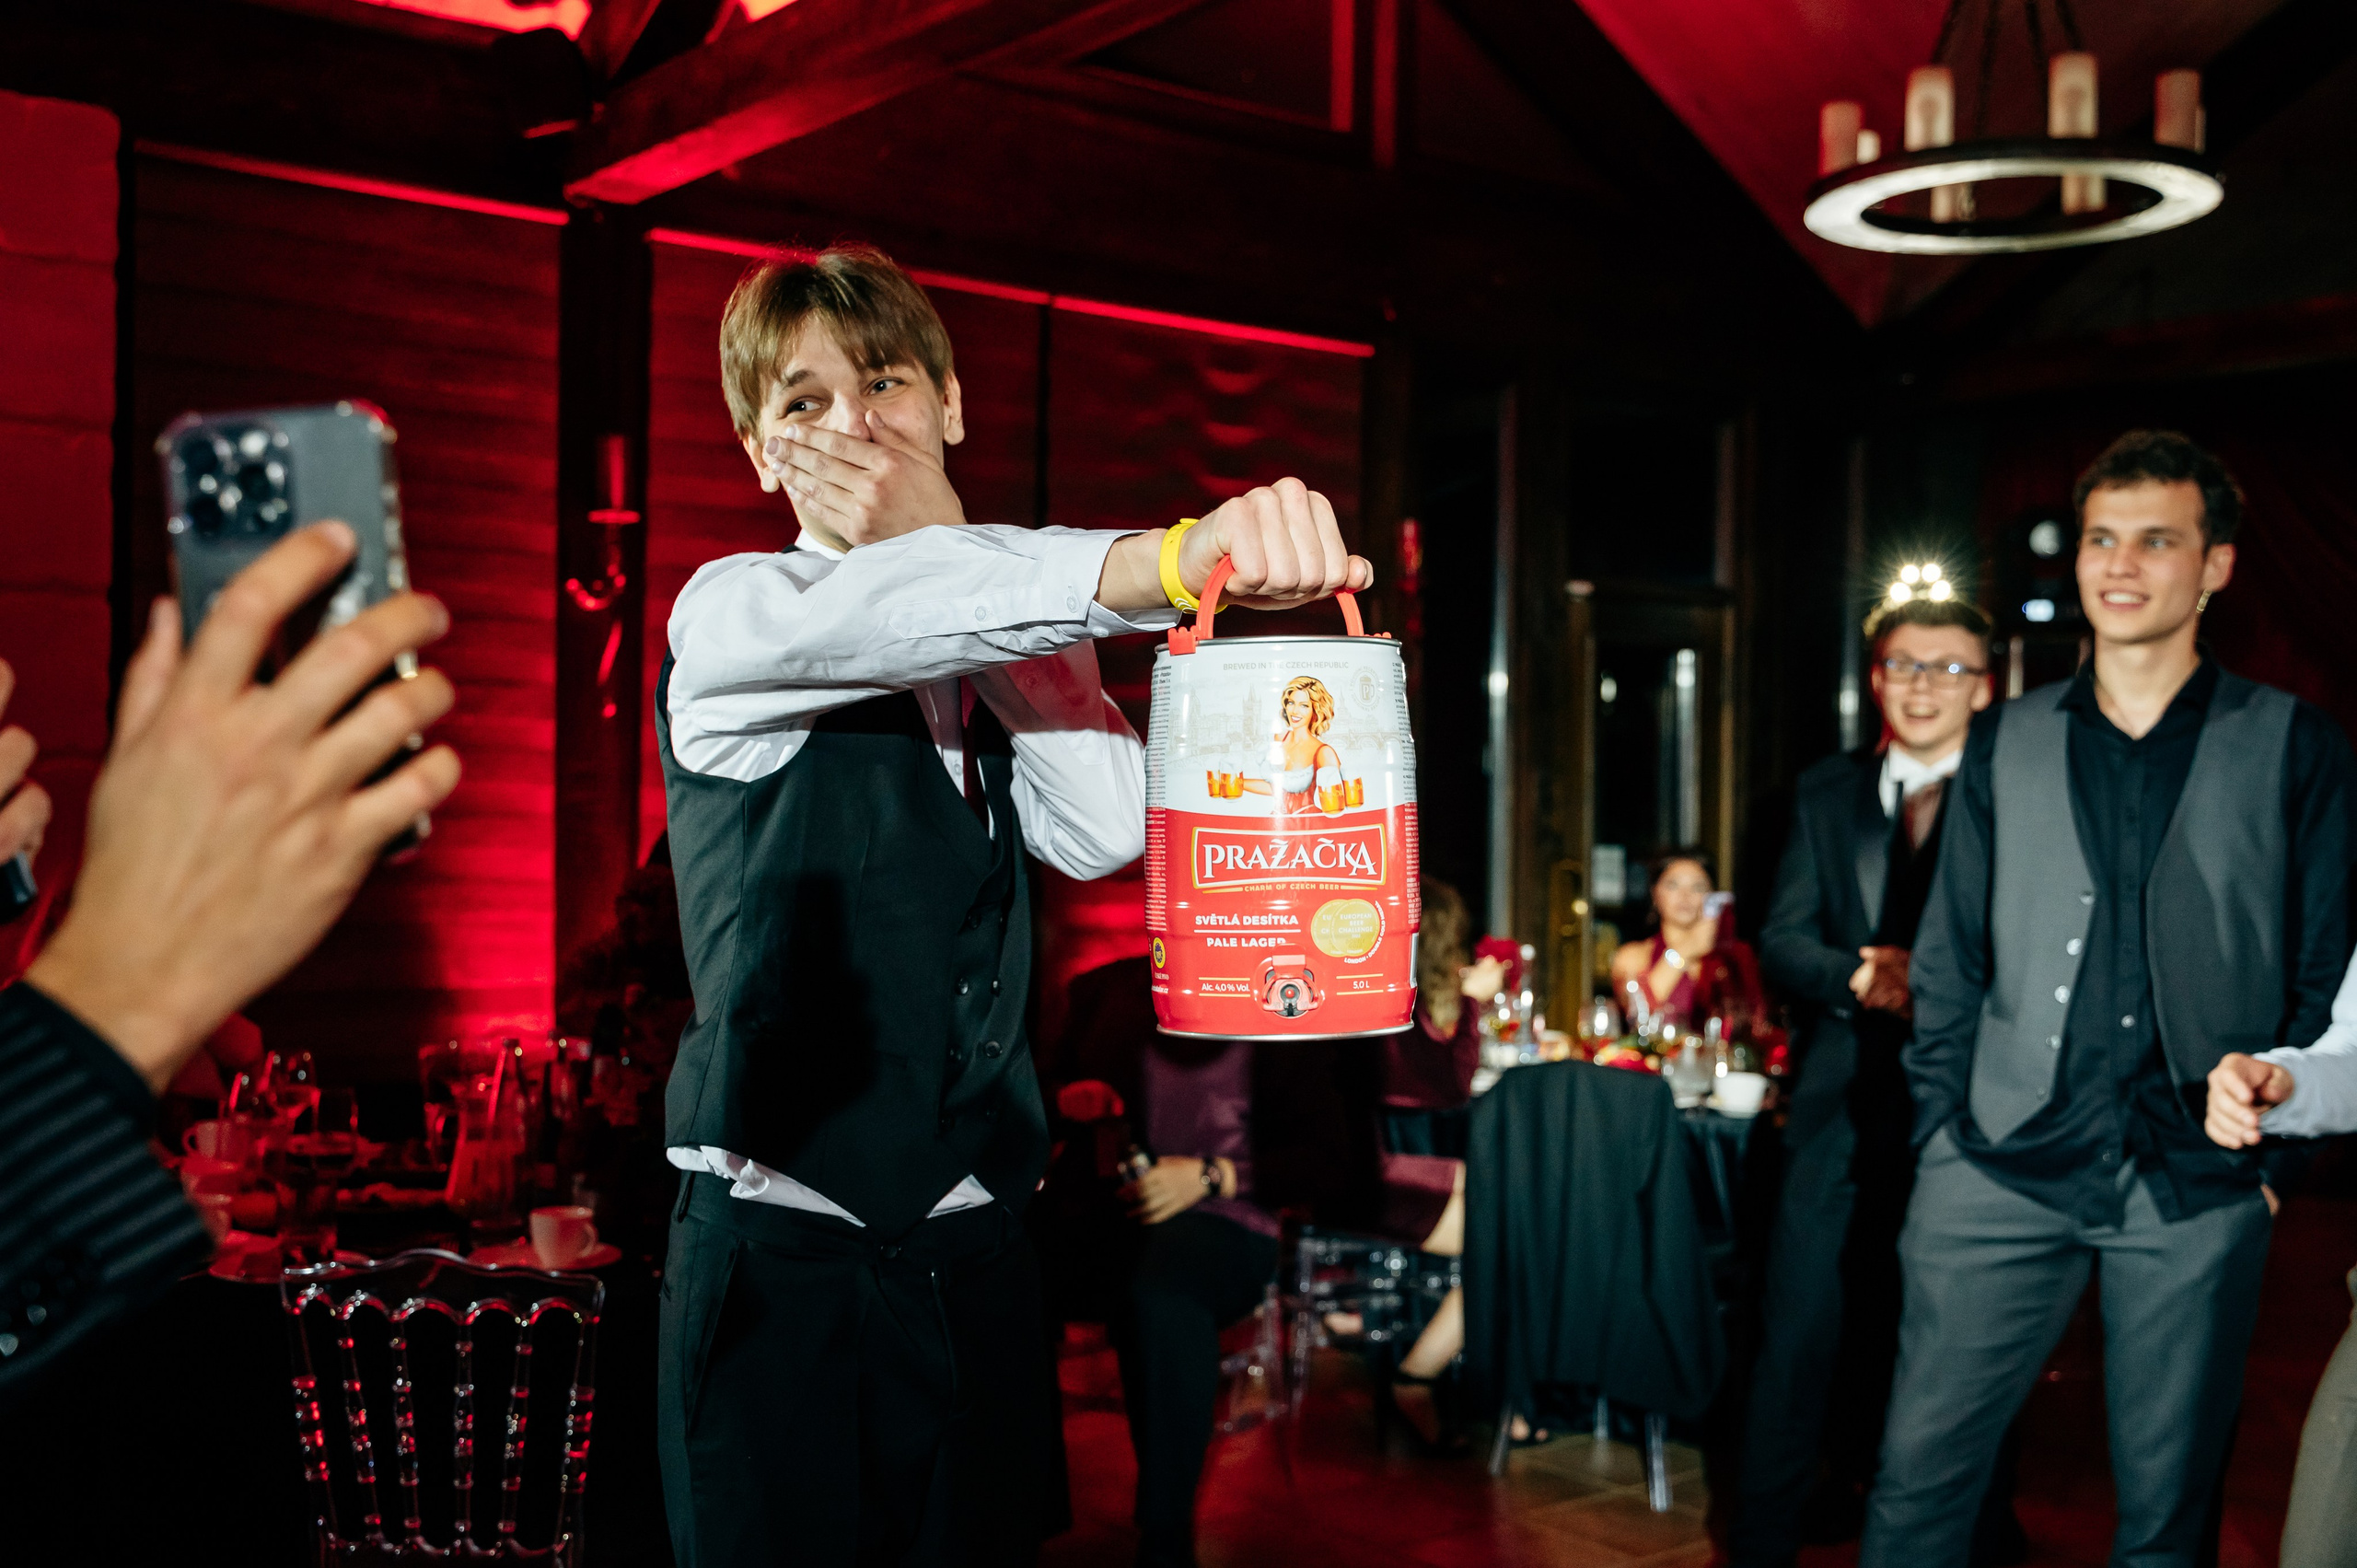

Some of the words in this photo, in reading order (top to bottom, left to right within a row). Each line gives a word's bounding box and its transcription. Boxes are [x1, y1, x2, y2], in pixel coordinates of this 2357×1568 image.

[1285, 661, 1312, 669] CZECH
[1314, 661, 1349, 669] REPUBLIC
[1202, 838, 1377, 878] PRAŽAČKA
[1195, 913, 1240, 925] SVĚTLÁ
[1243, 913, 1298, 925] DESÍTKA
[1206, 937, 1237, 947] PALE
[1368, 936, 1383, 958] DOUBLE
[1202, 982, 1214, 992] Alc.
[1236, 983, 1250, 992] Vol.
[1353, 981, 1364, 990] 5,0
